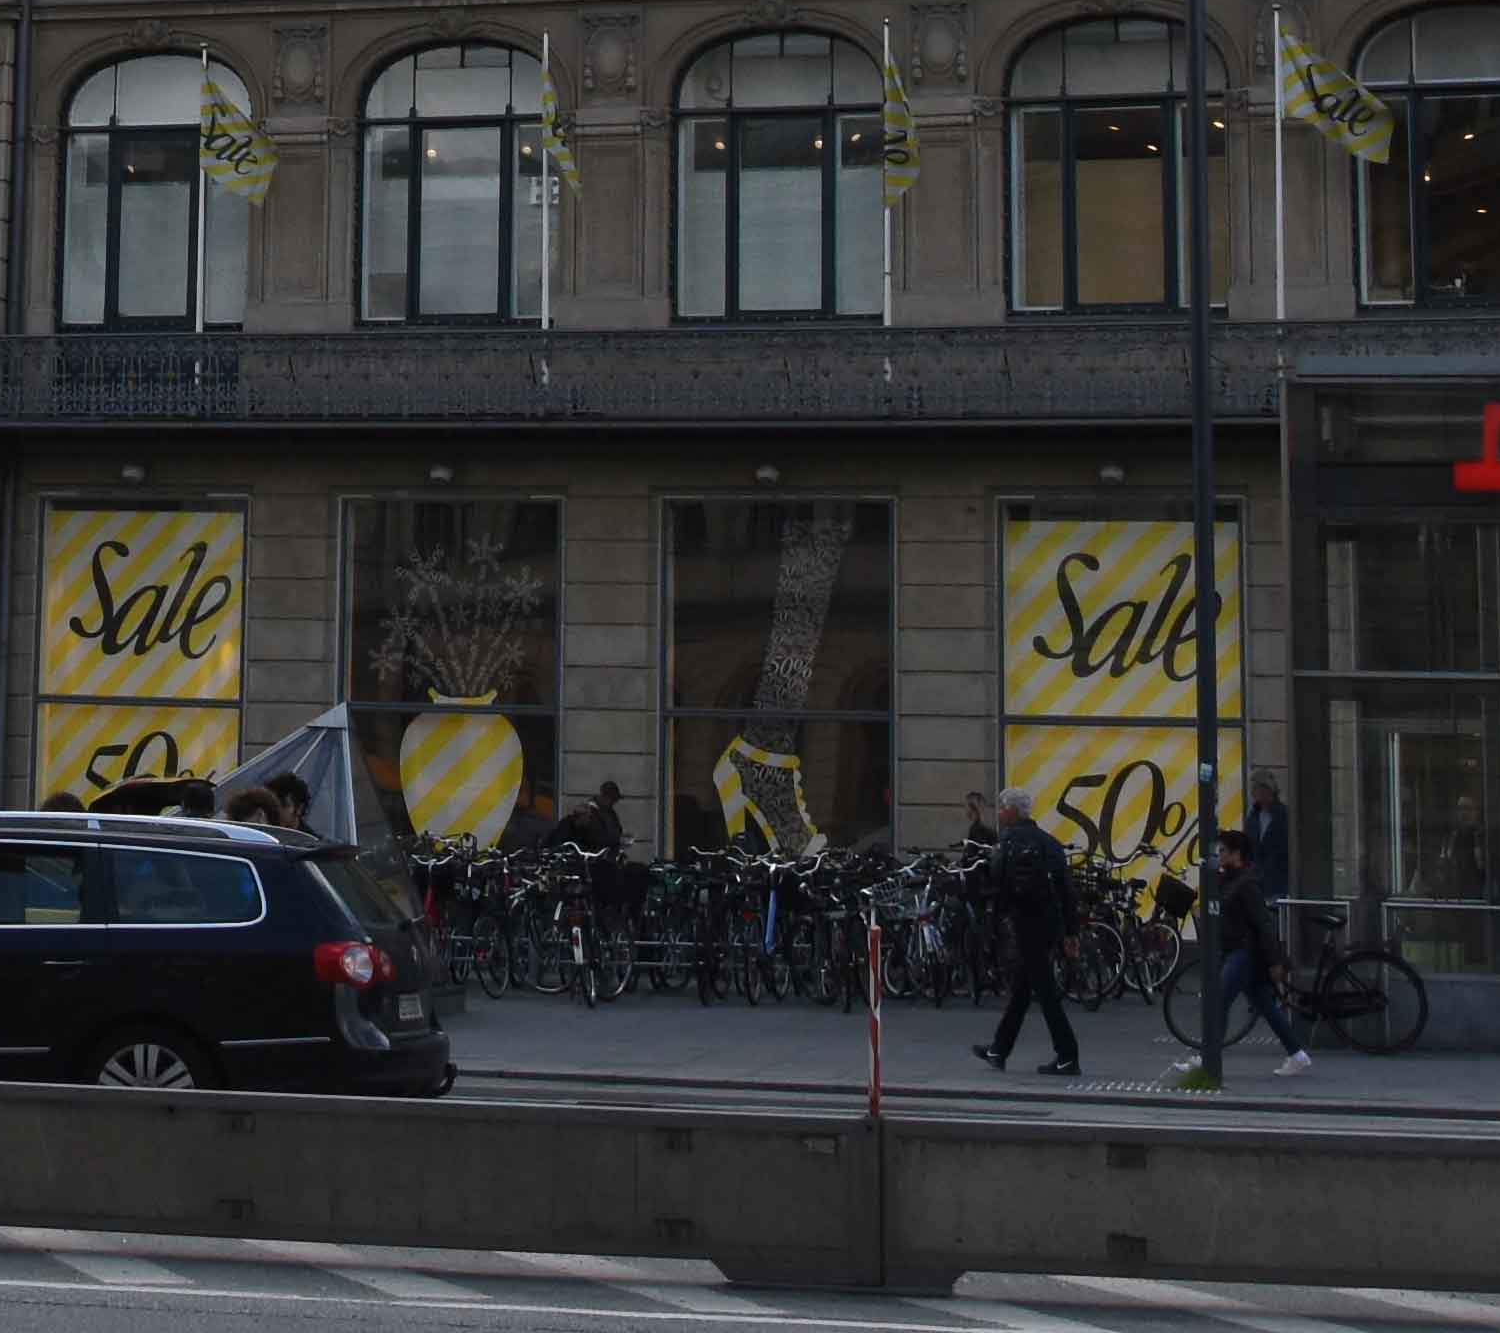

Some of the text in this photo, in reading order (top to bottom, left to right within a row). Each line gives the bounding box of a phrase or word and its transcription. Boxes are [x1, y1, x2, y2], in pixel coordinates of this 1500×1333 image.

[1305, 64, 1375, 136] Sale
[69, 540, 232, 659] Sale
[1033, 553, 1222, 682] Sale
[86, 731, 216, 789] 50
